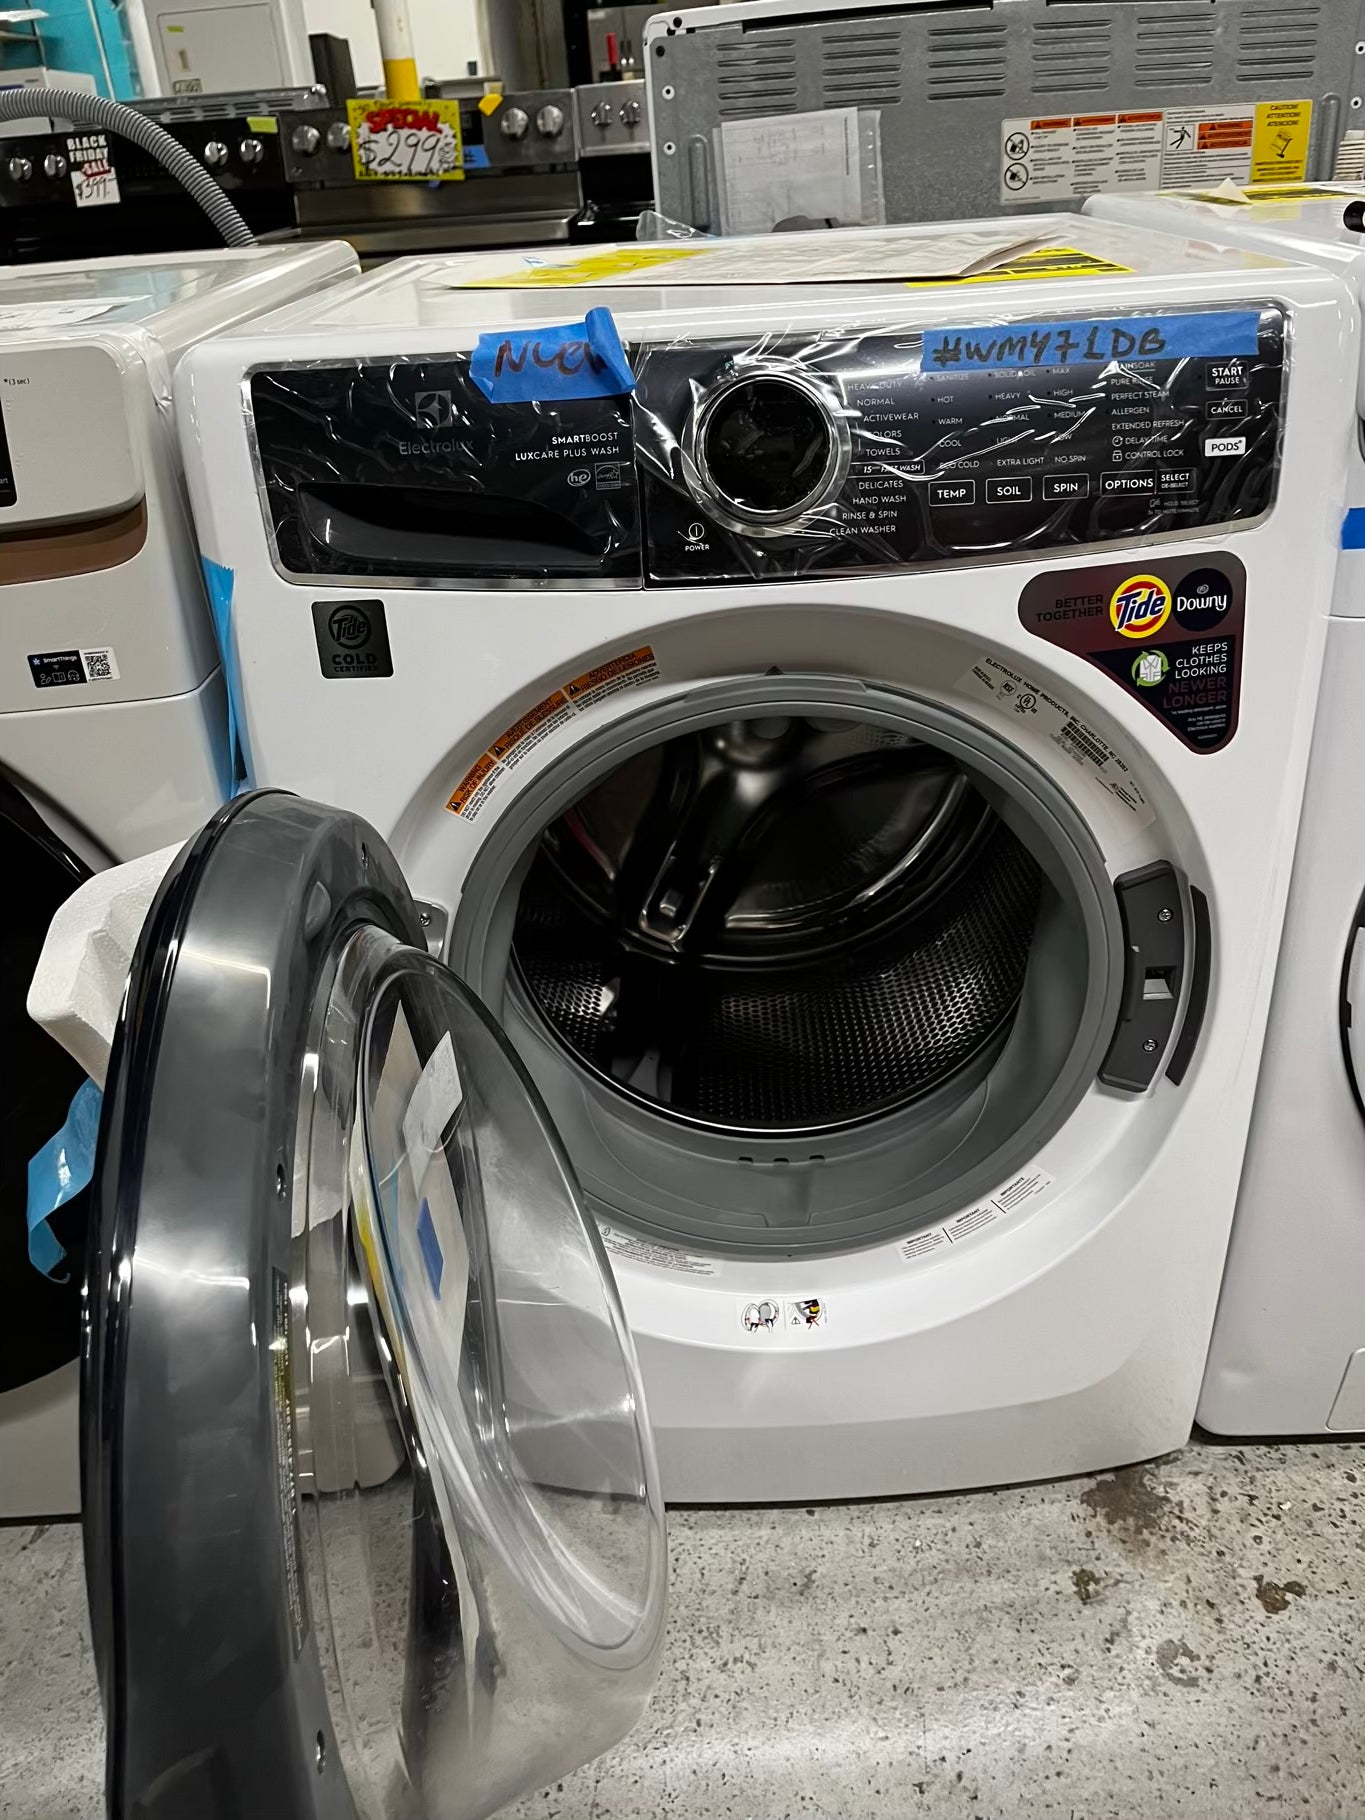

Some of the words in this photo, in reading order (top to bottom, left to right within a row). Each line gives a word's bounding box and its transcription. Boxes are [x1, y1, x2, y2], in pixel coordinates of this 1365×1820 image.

[67, 135, 107, 150] BLACK
[69, 147, 108, 163] FRIDAY
[360, 130, 440, 172] $299
[1211, 366, 1243, 377] START
[1111, 392, 1141, 400] PERFECT
[1144, 390, 1169, 398] STEAM
[856, 398, 895, 406] NORMAL
[1054, 411, 1085, 419] MEDIUM
[1111, 407, 1150, 416] ALLERGEN
[1211, 406, 1242, 414] CANCEL
[863, 412, 919, 422] ACTIVEWEAR
[938, 417, 962, 425] WARM
[1112, 422, 1150, 431] EXTENDED
[1152, 420, 1184, 428] REFRESH
[552, 432, 618, 445] SMARTBOOST
[938, 439, 961, 447] COOL
[1125, 436, 1149, 445] DELAY
[399, 438, 474, 455] Electrolux
[515, 448, 560, 460] LUXCARE
[563, 447, 587, 457] PLUS
[591, 445, 619, 455] WASH
[865, 448, 900, 457] TOWELS
[1125, 450, 1161, 459] CONTROL
[957, 460, 979, 469] COLD
[996, 458, 1021, 467] EXTRA
[1022, 457, 1044, 466] LIGHT
[1161, 473, 1190, 481] SELECT
[858, 480, 904, 490] DELICATES
[1053, 482, 1079, 493] SPIN
[1104, 478, 1154, 490] OPTIONS
[1161, 481, 1188, 489] DE-SELECT
[936, 487, 967, 499] TEMP
[996, 485, 1022, 496] SOIL
[881, 495, 907, 503] WASH
[842, 511, 867, 520] RINSE
[869, 511, 876, 519] &
[878, 510, 898, 518] SPIN
[829, 526, 858, 536] CLEAN
[860, 525, 897, 534] WASHER
[1055, 593, 1104, 609] BETTER
[1176, 594, 1228, 612] Downy
[1034, 606, 1104, 623] TOGETHER
[1113, 587, 1167, 632] Tide
[333, 614, 367, 642] Tide
[1192, 642, 1228, 655] KEEPS
[331, 653, 377, 666] COLD
[1175, 653, 1227, 668] CLOTHES
[985, 657, 1022, 683] ELECTROLUX
[1022, 681, 1040, 694] HOME
[1175, 664, 1227, 679] LOOKING
[580, 673, 607, 690] RIESGO
[1168, 676, 1227, 694] NEWER
[1162, 691, 1227, 708] LONGER
[503, 727, 527, 749] RISQUE
[458, 764, 481, 792] WARNING
[459, 788, 472, 803] RISK
[469, 779, 478, 789] OF
[476, 758, 495, 781] INJURY
